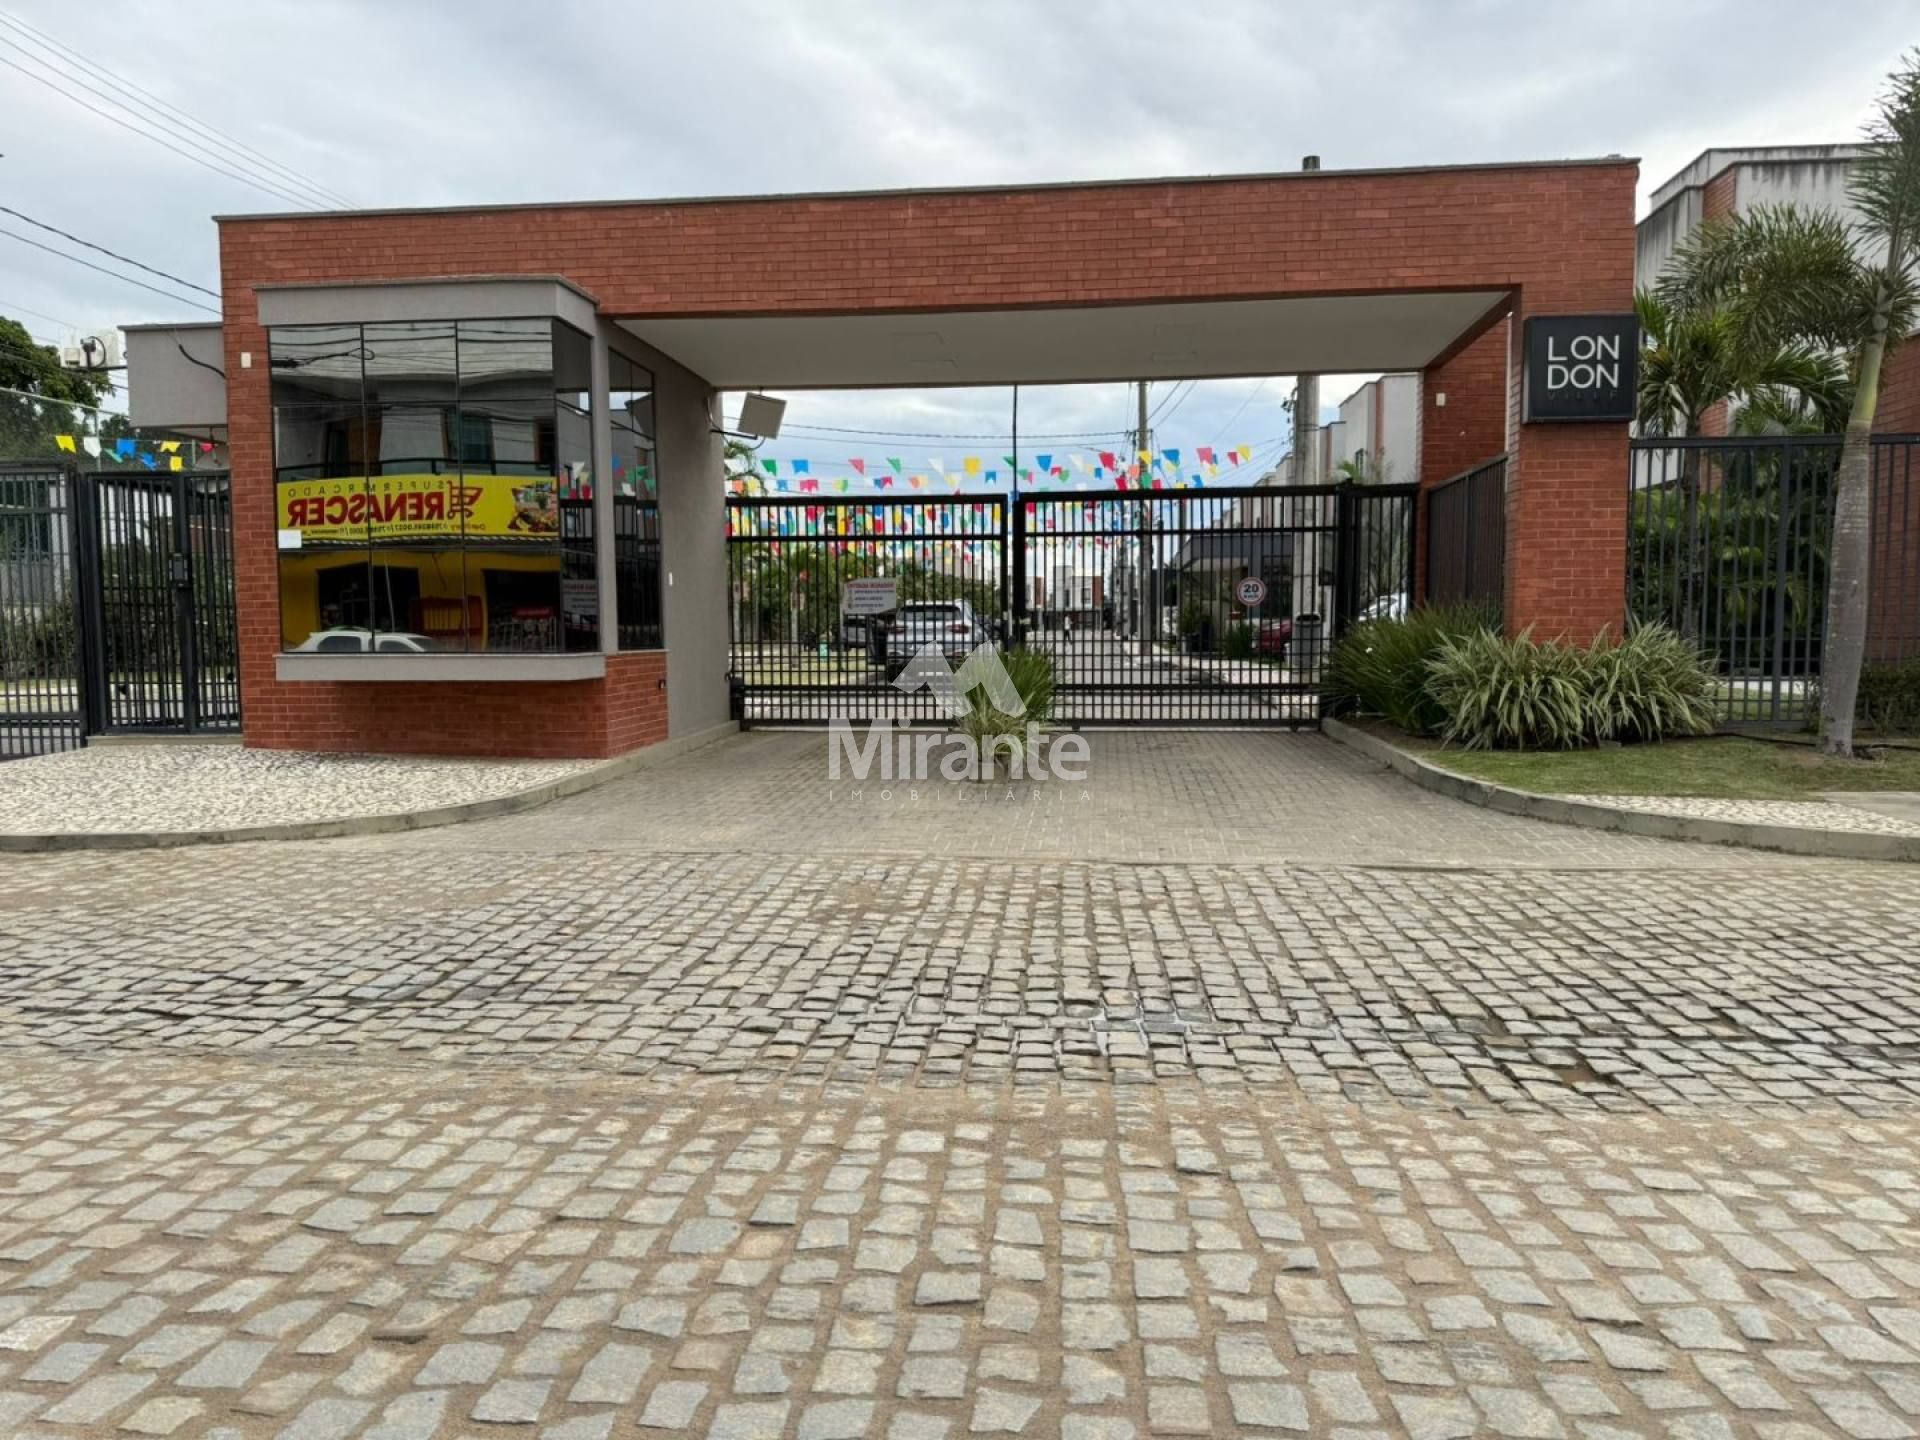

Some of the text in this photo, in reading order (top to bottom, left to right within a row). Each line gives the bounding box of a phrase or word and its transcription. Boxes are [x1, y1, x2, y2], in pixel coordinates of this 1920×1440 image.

[1547, 335, 1621, 361] LON
[1547, 363, 1619, 389] DON
[1243, 584, 1260, 593] 20
